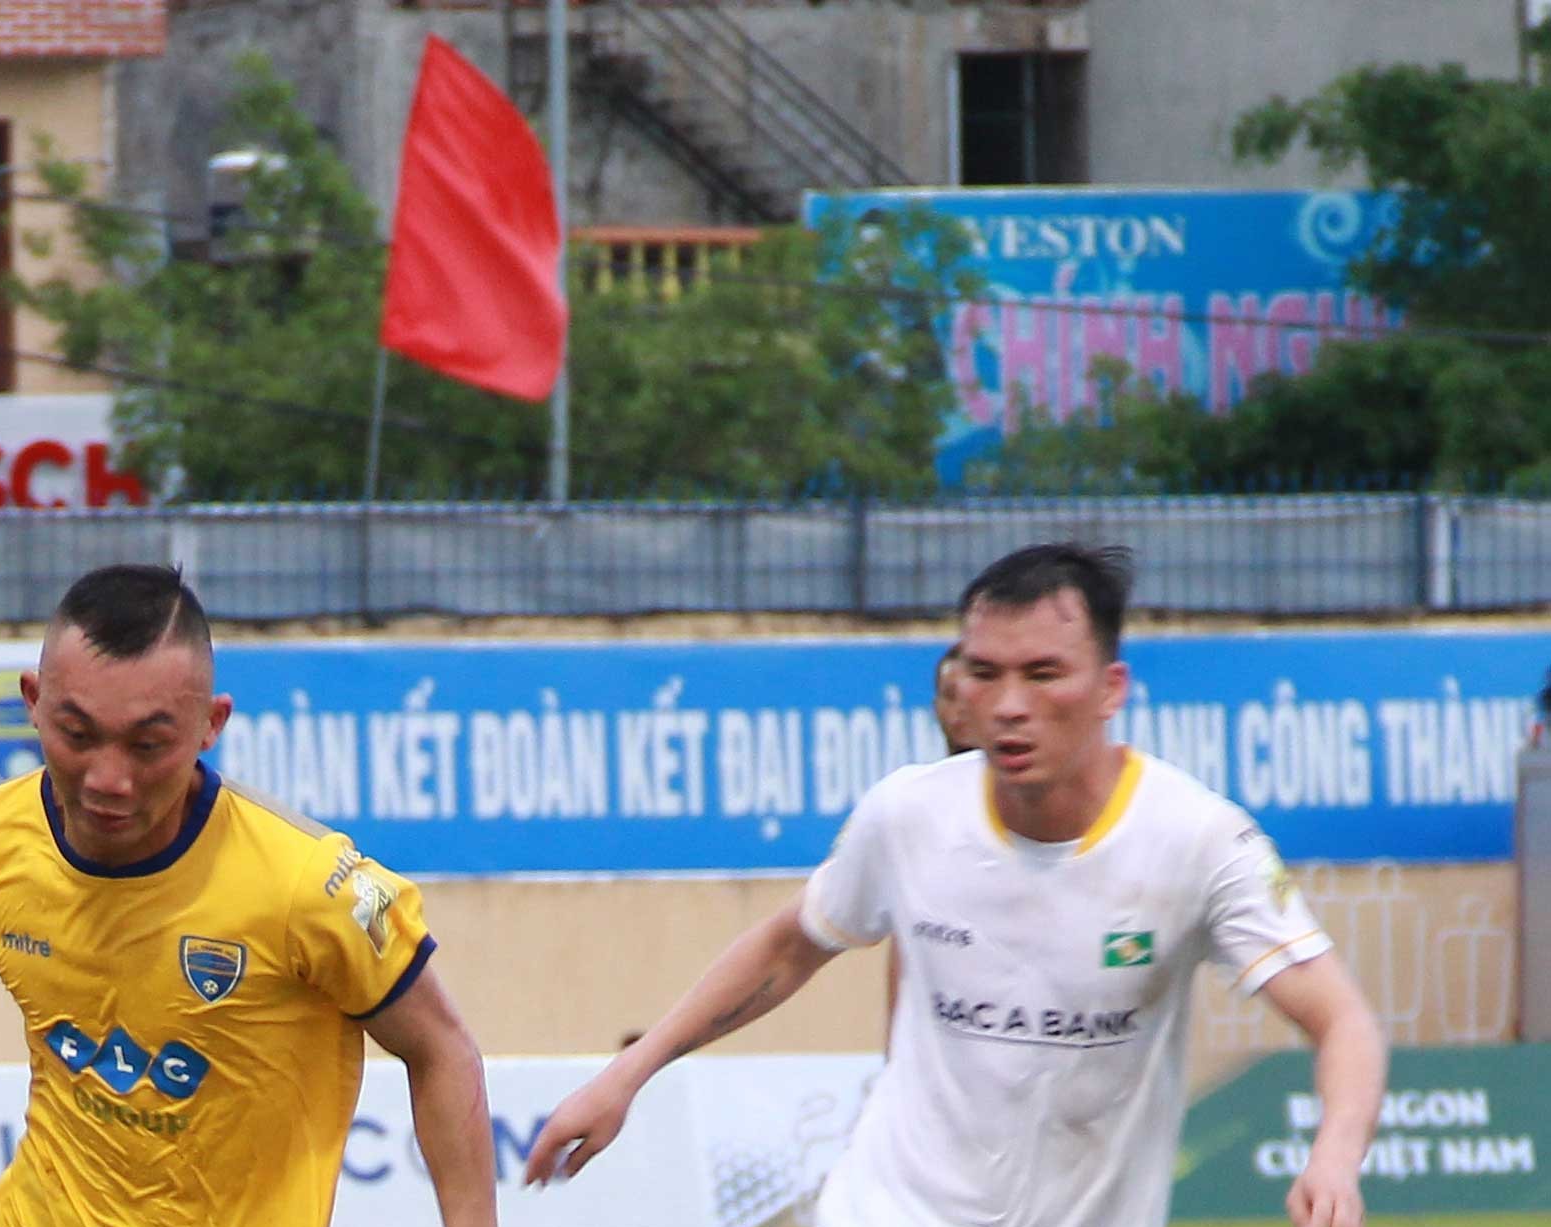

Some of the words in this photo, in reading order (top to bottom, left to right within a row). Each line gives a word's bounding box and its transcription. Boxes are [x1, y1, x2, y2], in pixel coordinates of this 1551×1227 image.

[961, 213, 1187, 259] VESTON
[367, 676, 461, 820] KẾT
[469, 687, 606, 818] ĐOÀN
[616, 676, 708, 818] KẾT
[717, 707, 804, 840] ĐẠI
[1237, 678, 1371, 811] CÔNG
[2, 931, 53, 958] mitre
[1439, 1135, 1536, 1175] NAM
